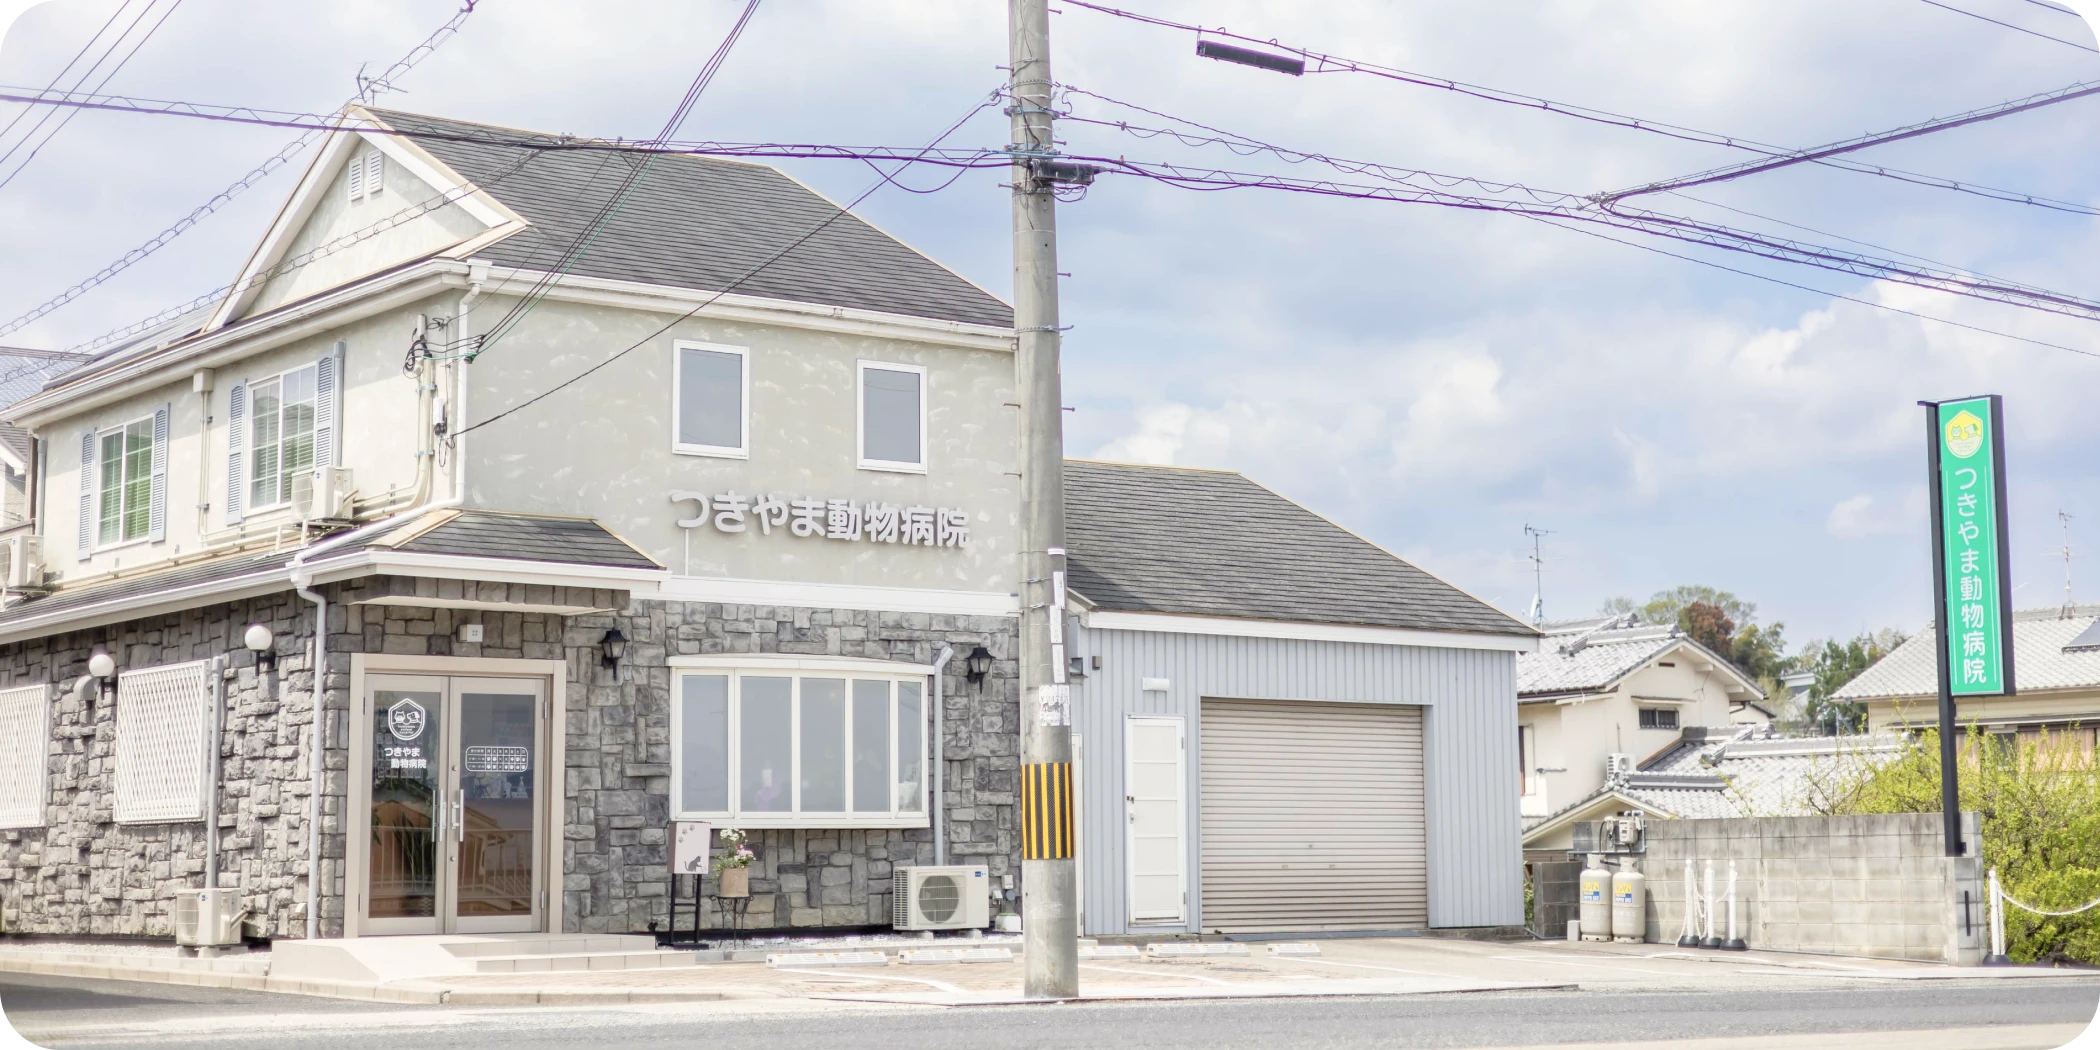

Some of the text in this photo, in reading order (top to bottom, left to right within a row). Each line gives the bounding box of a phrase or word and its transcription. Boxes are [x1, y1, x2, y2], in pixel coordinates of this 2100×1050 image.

[671, 489, 970, 549] つきやま動物病院
[1955, 467, 1986, 685] つきやま動物病院
[384, 746, 421, 757] つきやま
[390, 758, 427, 769] 動物病院
